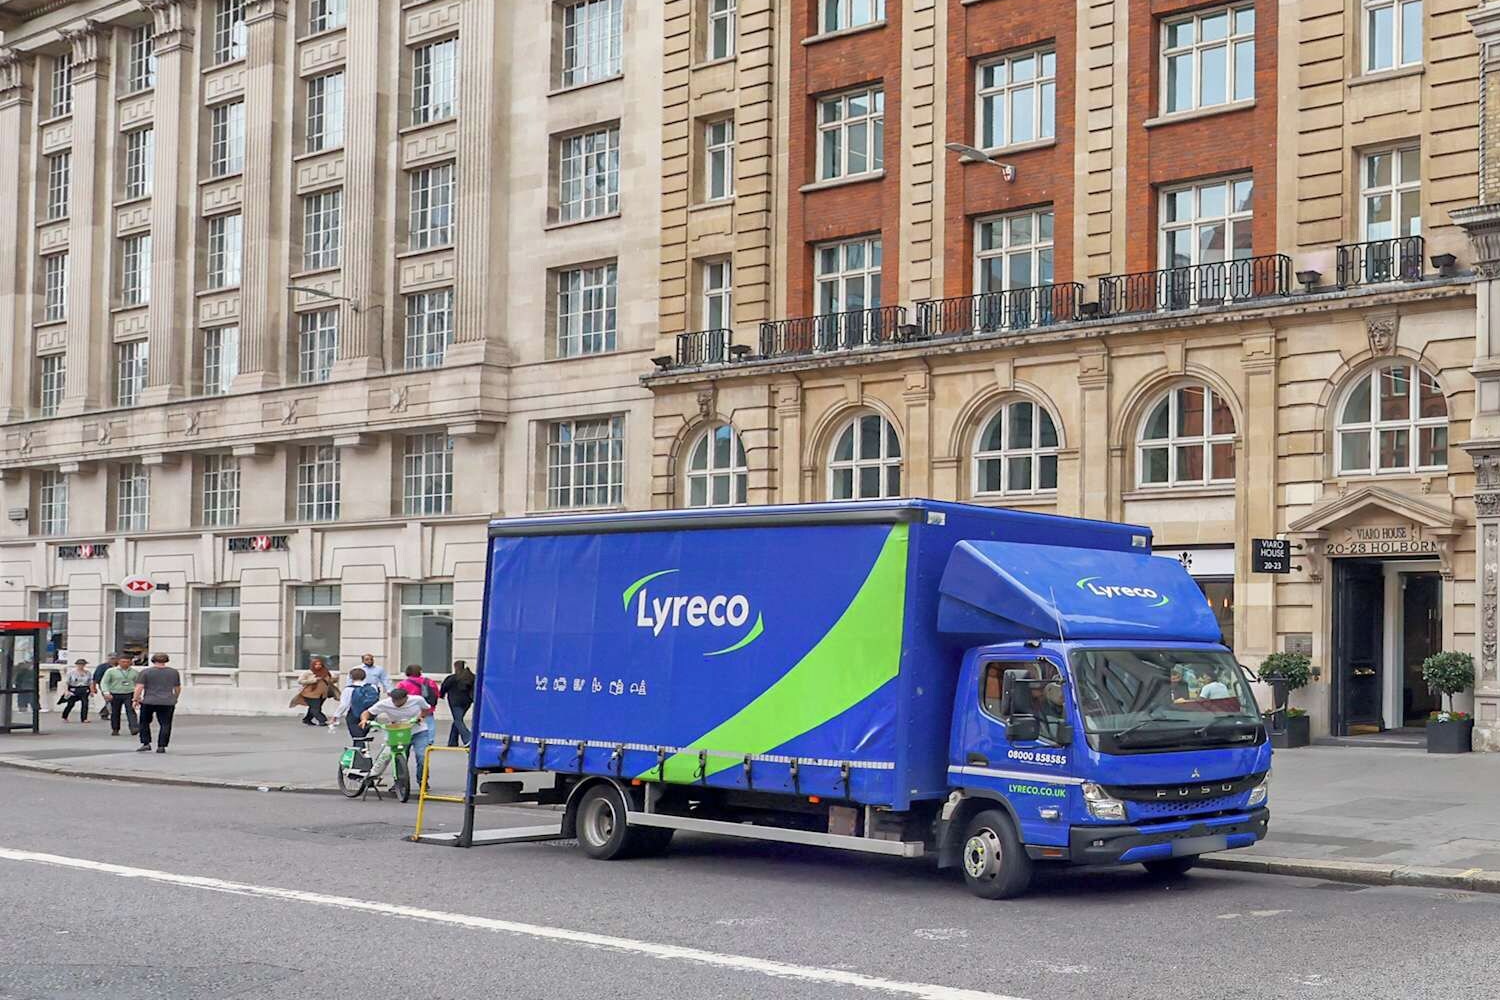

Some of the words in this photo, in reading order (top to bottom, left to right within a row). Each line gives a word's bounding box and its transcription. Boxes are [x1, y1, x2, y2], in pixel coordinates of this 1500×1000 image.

[1357, 528, 1380, 540] VIARO
[1382, 527, 1407, 539] HOUSE
[1261, 540, 1284, 549] VIARO
[1327, 543, 1367, 554] 20-23
[1260, 548, 1285, 558] HOUSE
[1264, 561, 1282, 570] 20-23
[1086, 582, 1158, 598] Lyreco
[636, 587, 750, 638] Lyreco
[1007, 749, 1034, 761] 08000
[1035, 752, 1067, 765] 858585
[1008, 783, 1067, 798] LYRECO.CO.UK
